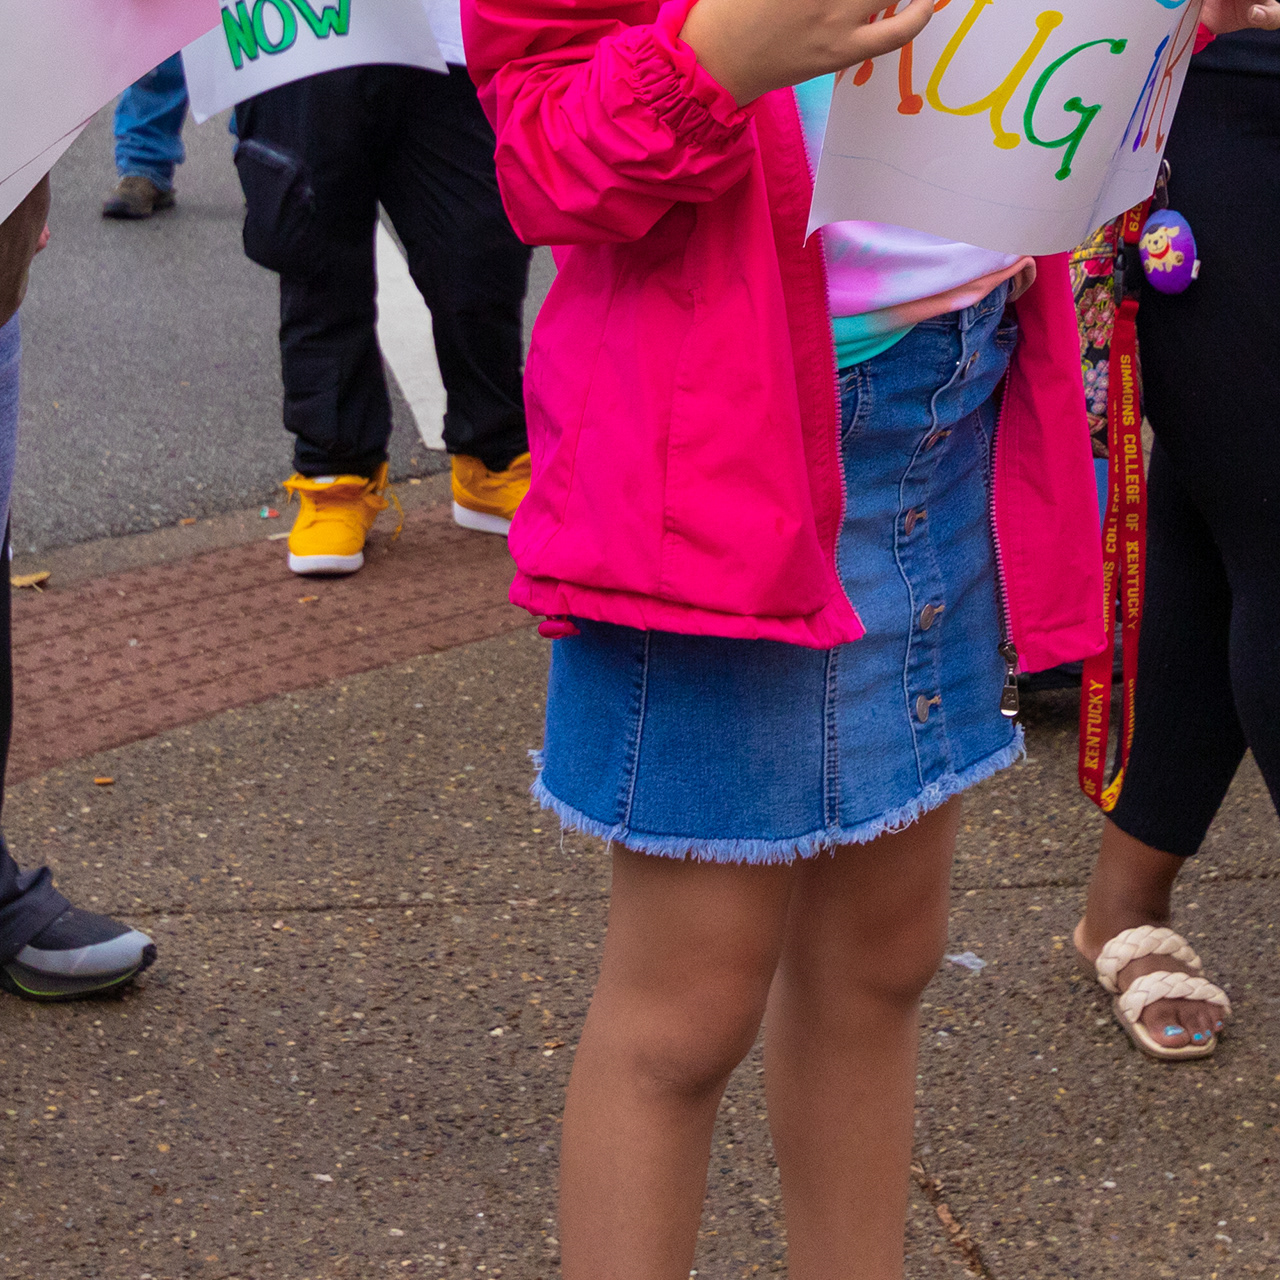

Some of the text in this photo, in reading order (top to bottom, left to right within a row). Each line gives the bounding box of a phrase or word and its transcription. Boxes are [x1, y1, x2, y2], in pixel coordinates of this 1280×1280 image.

[1120, 354, 1141, 631] SIMMONS COLLEGE OF KENTUCKY
[1084, 679, 1105, 770] KENTUCKY
